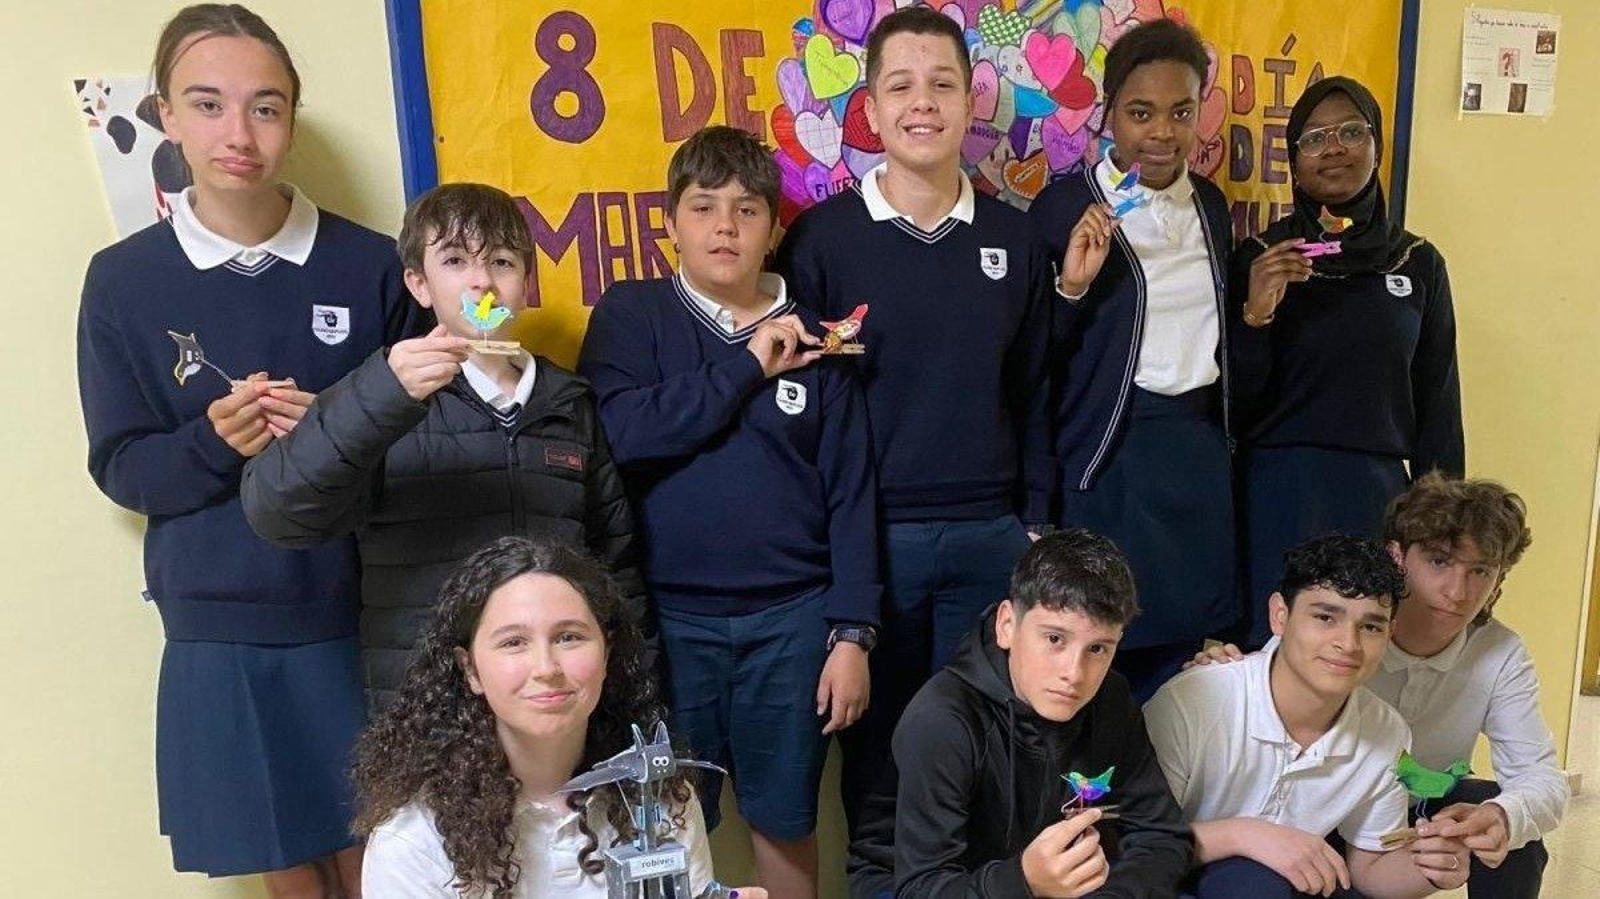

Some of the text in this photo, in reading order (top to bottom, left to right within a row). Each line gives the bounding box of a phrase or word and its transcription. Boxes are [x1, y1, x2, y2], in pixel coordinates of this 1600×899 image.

[530, 10, 767, 144] 8 DE
[815, 176, 850, 198] FUER
[1229, 123, 1290, 184] DE
[513, 191, 676, 308] MAR
